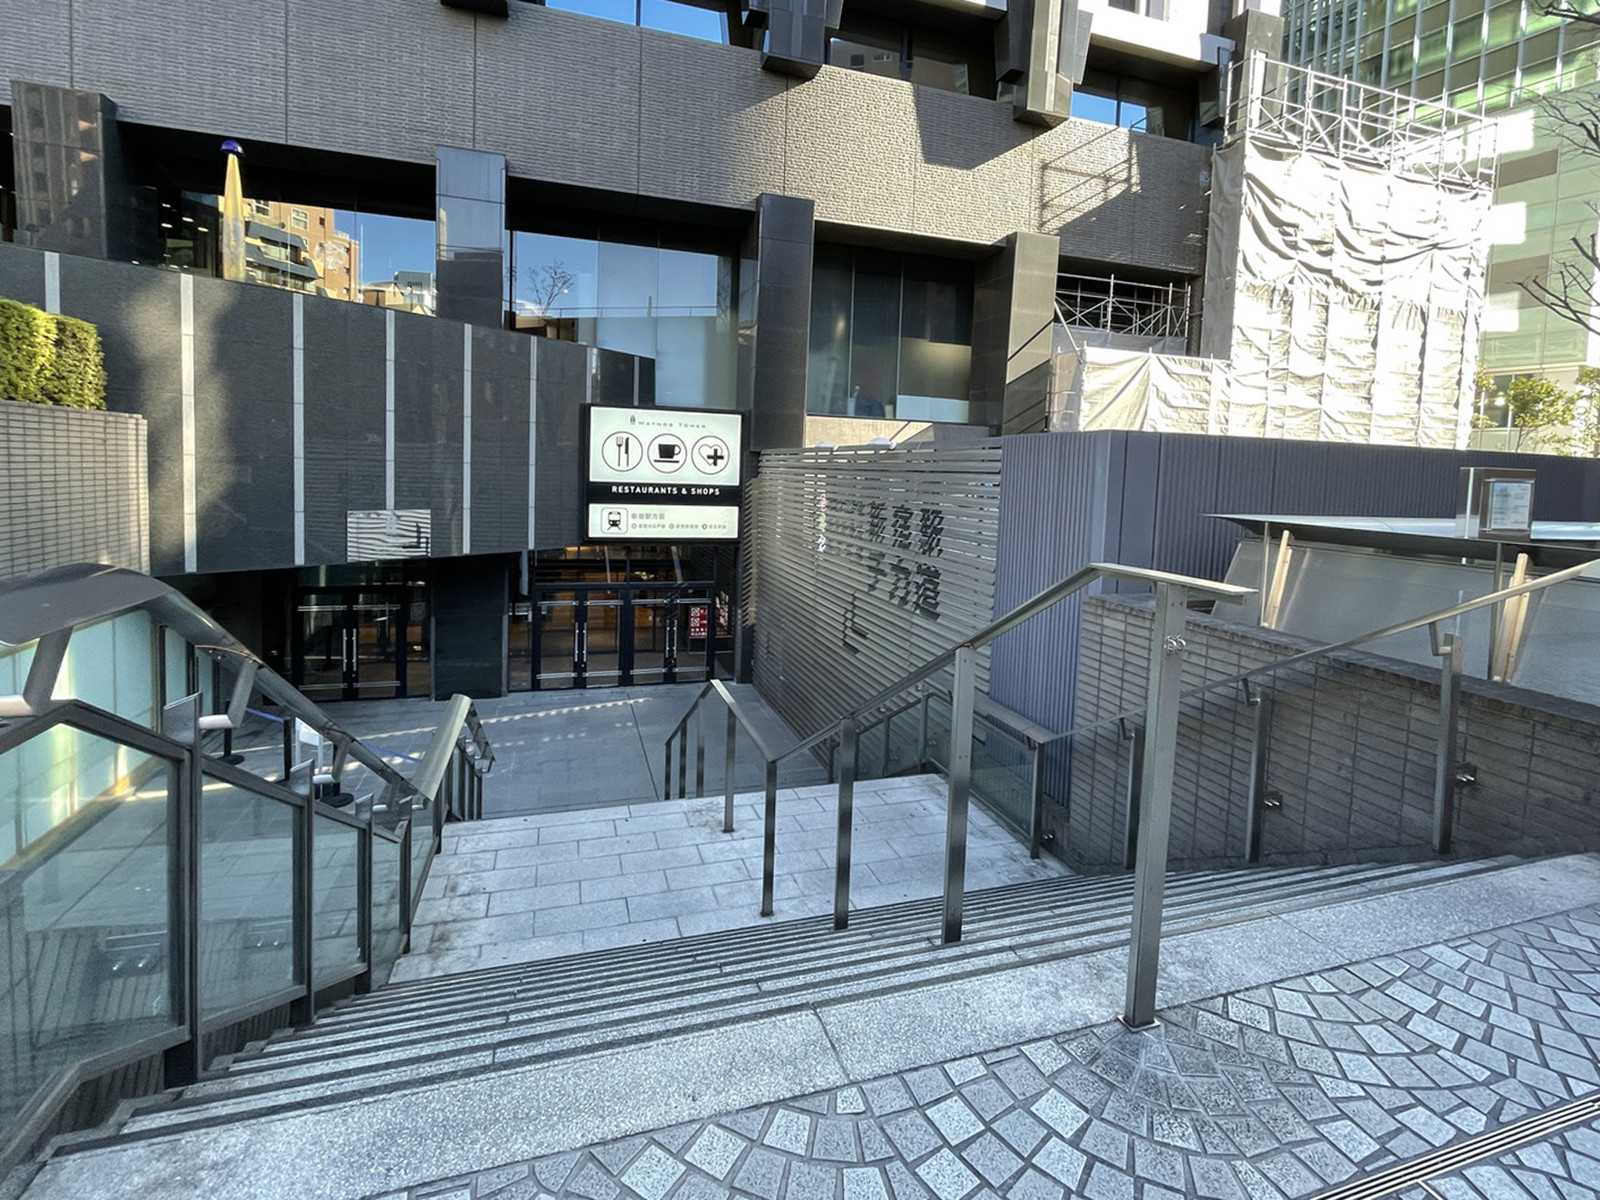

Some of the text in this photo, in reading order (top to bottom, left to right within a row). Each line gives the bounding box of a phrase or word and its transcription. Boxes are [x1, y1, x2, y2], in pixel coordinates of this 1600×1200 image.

[611, 485, 720, 496] RESTAURANTS & SHOPS
